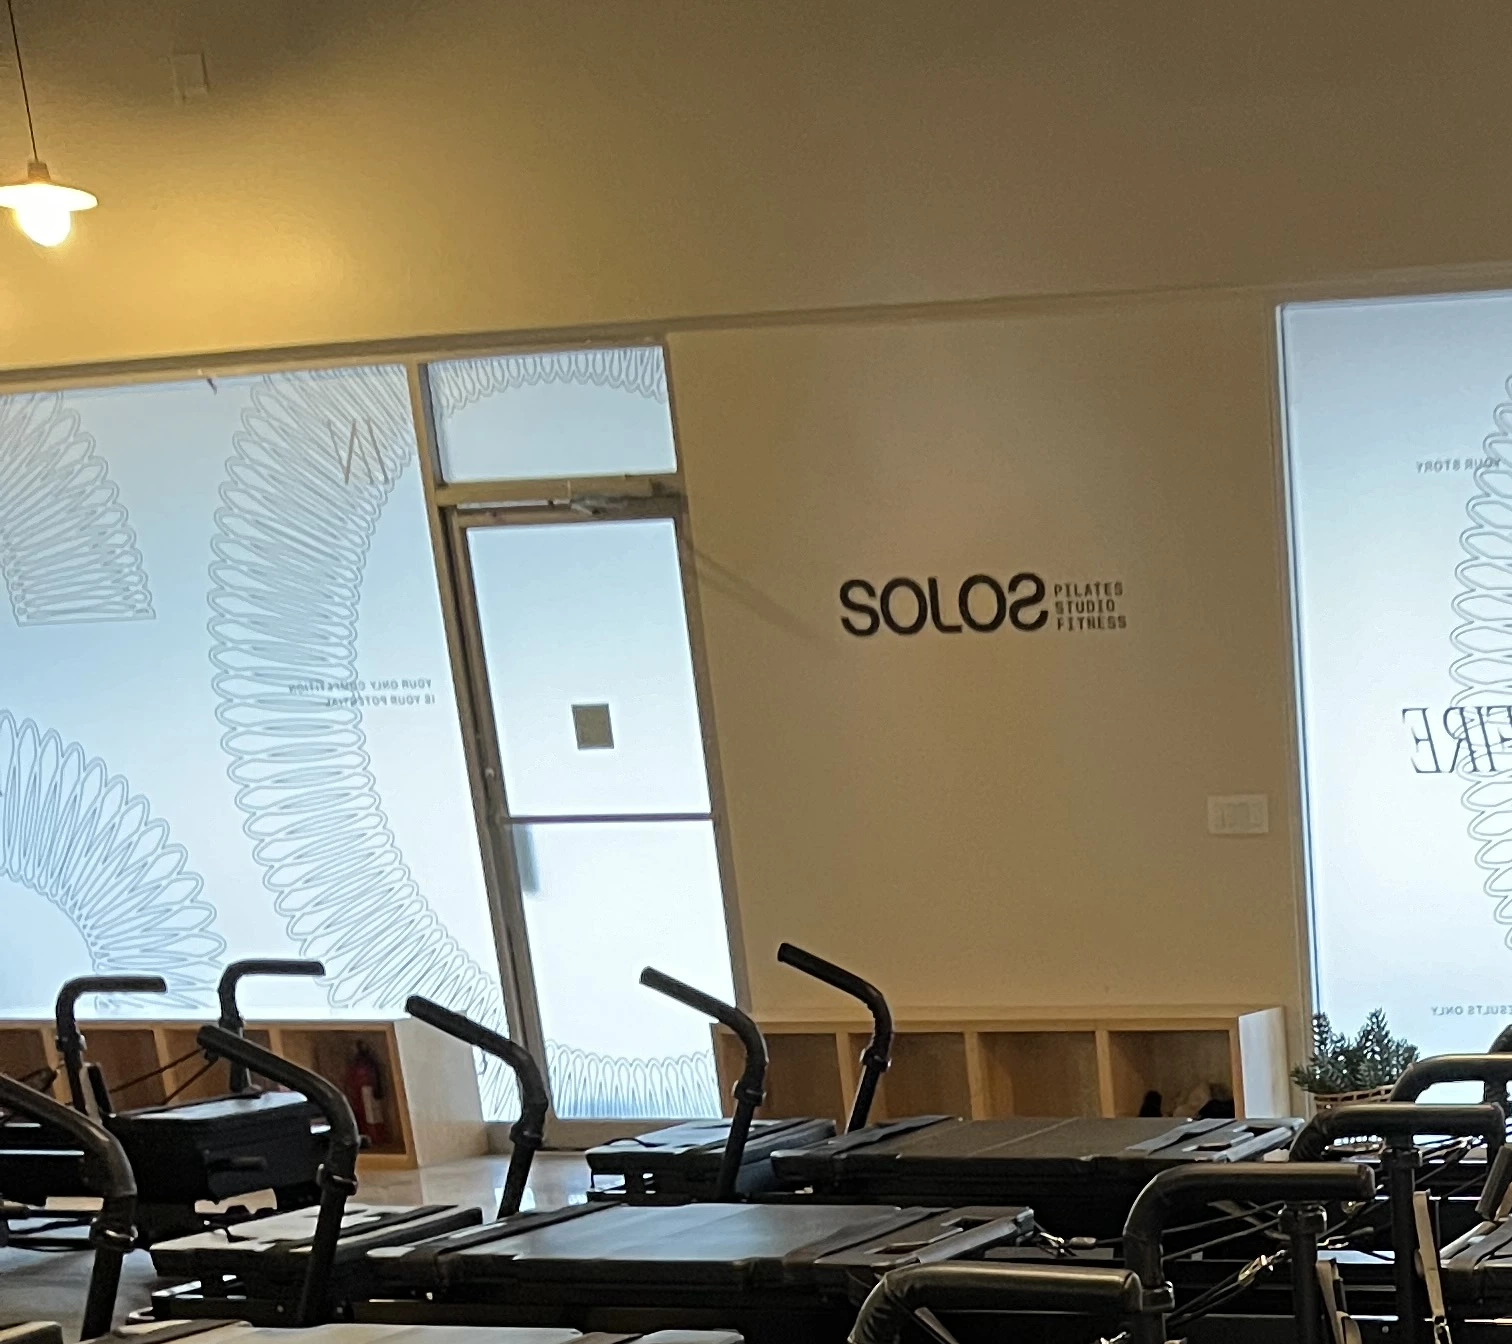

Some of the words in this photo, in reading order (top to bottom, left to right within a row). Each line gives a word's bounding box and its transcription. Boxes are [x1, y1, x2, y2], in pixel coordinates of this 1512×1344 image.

[1054, 581, 1124, 597] PILATES
[840, 572, 1048, 637] SOLOS
[1055, 599, 1115, 614] STUDIO
[1056, 615, 1127, 631] FITNESS
